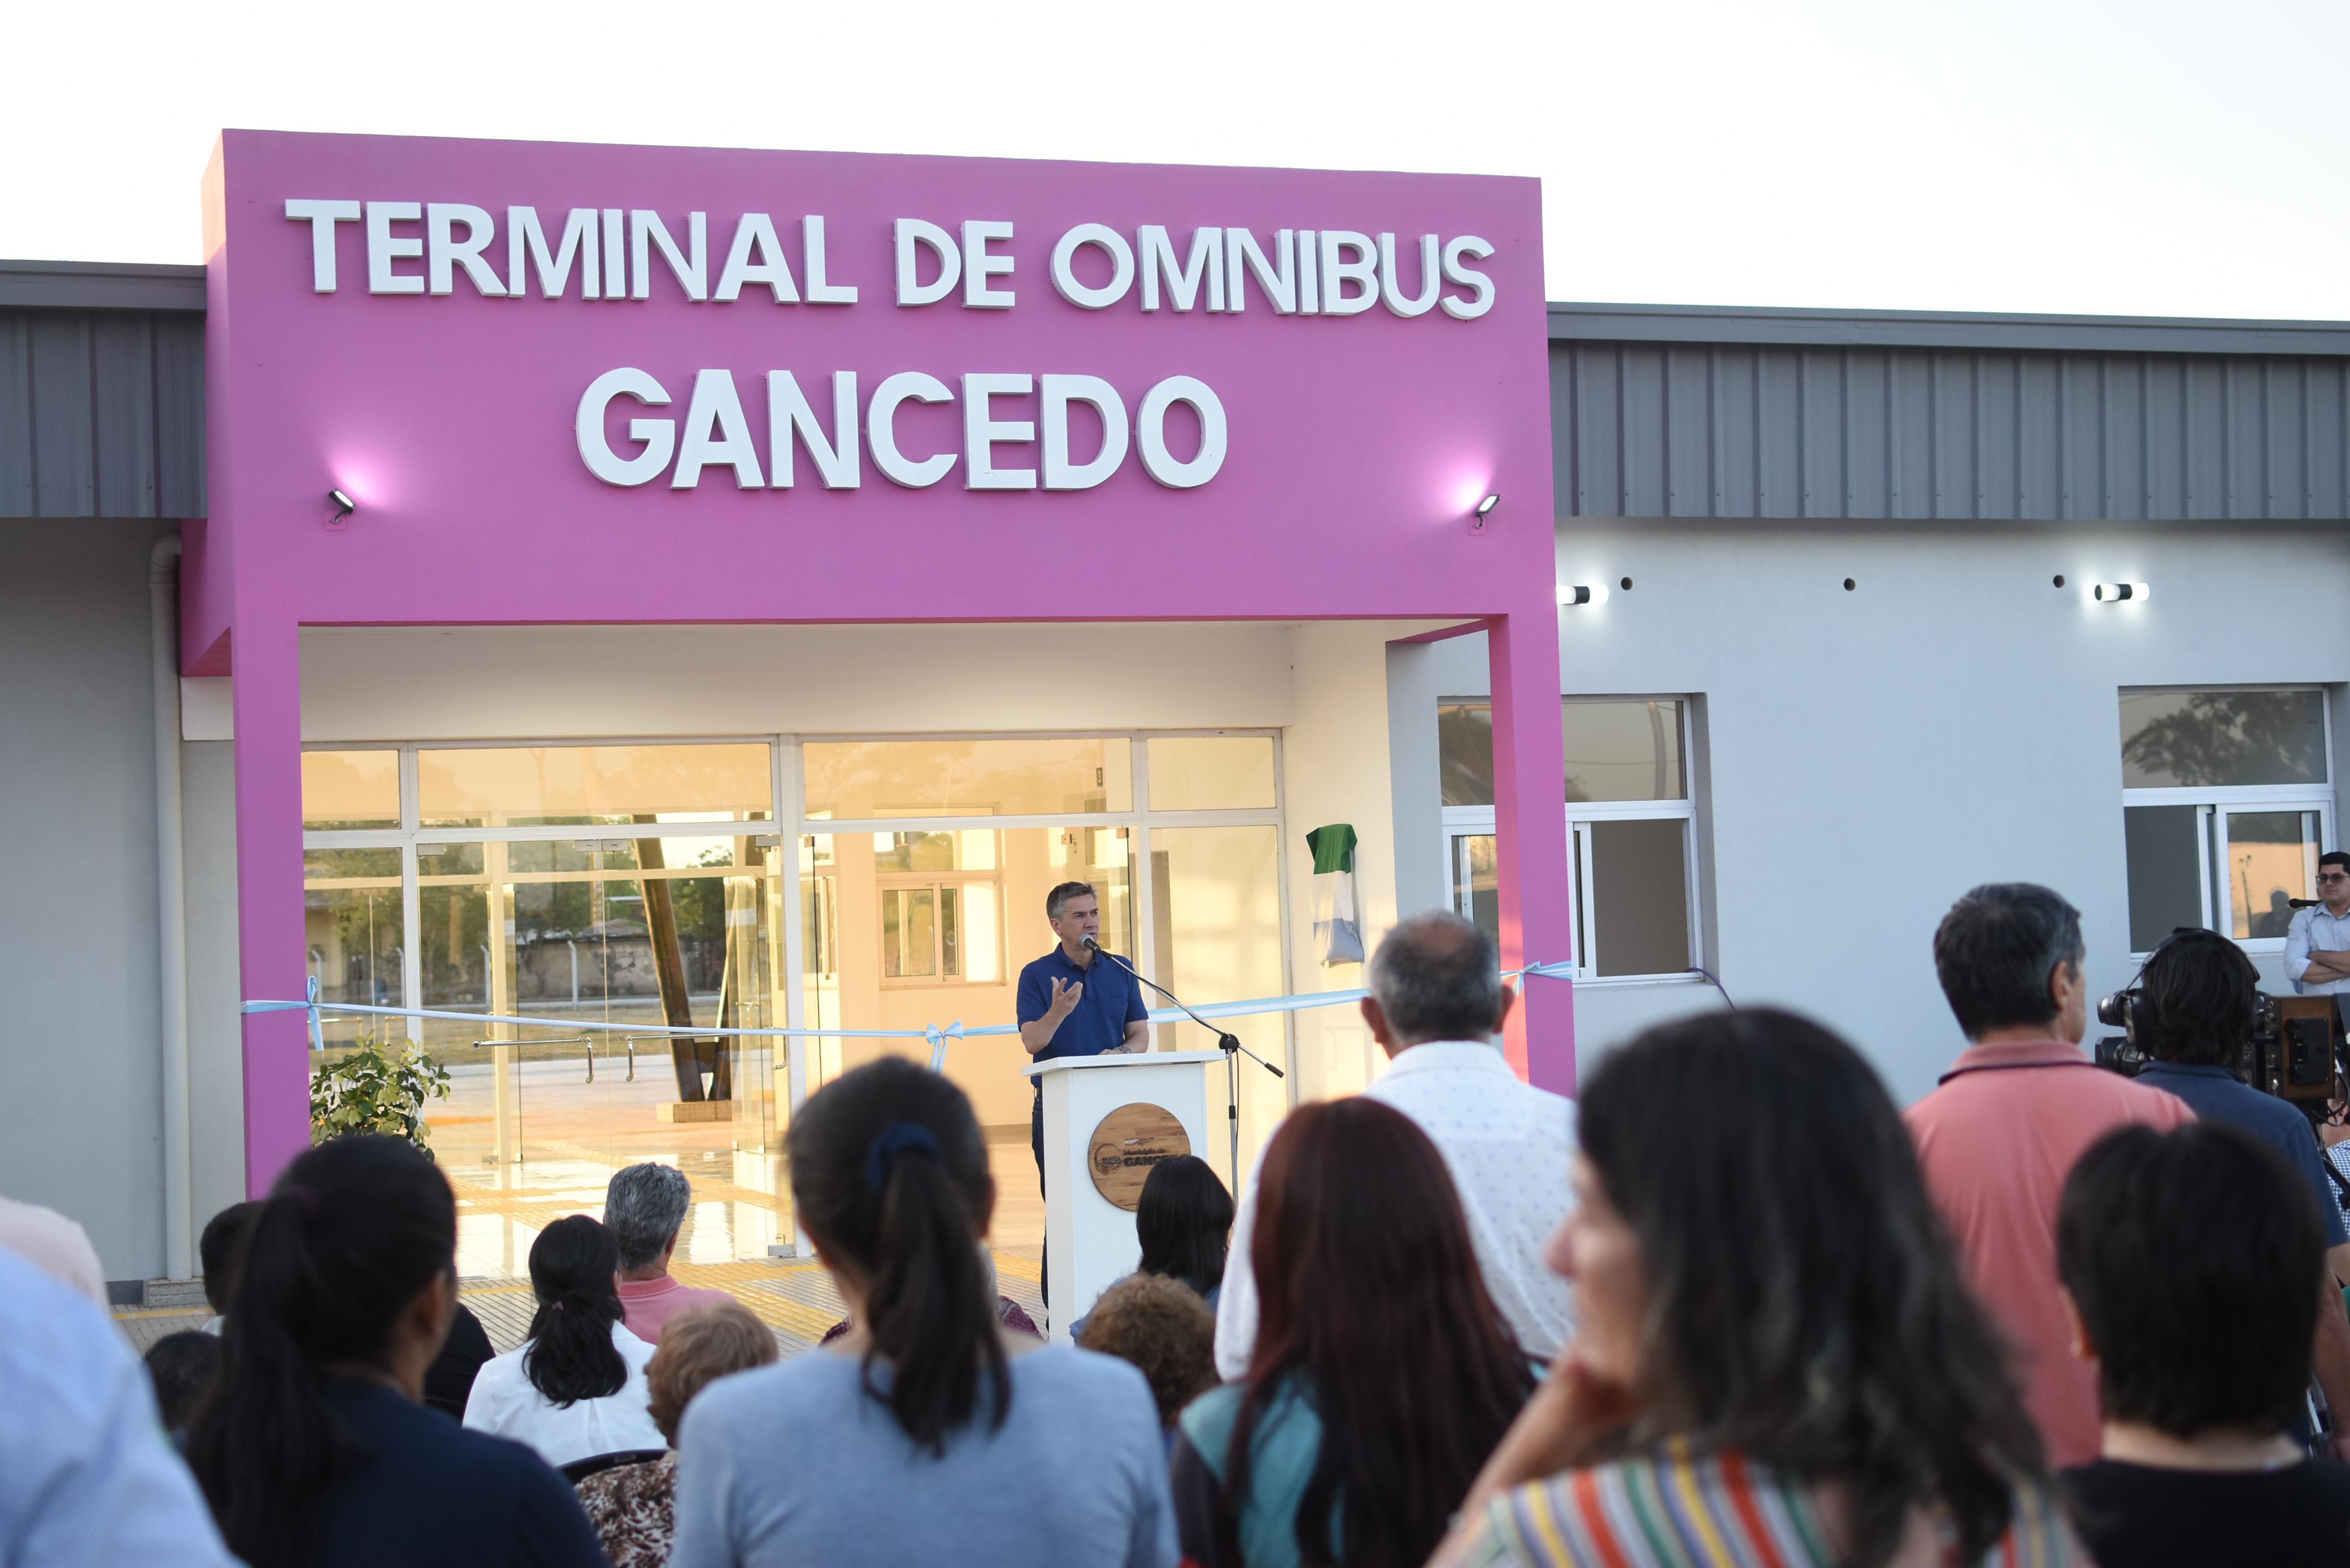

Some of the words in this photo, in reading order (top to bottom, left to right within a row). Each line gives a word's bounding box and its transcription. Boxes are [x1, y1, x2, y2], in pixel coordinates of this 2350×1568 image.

[285, 199, 859, 303] TERMINAL
[894, 218, 1016, 307] DE
[1051, 223, 1496, 320] OMNIBUS
[575, 367, 1228, 490] GANCEDO
